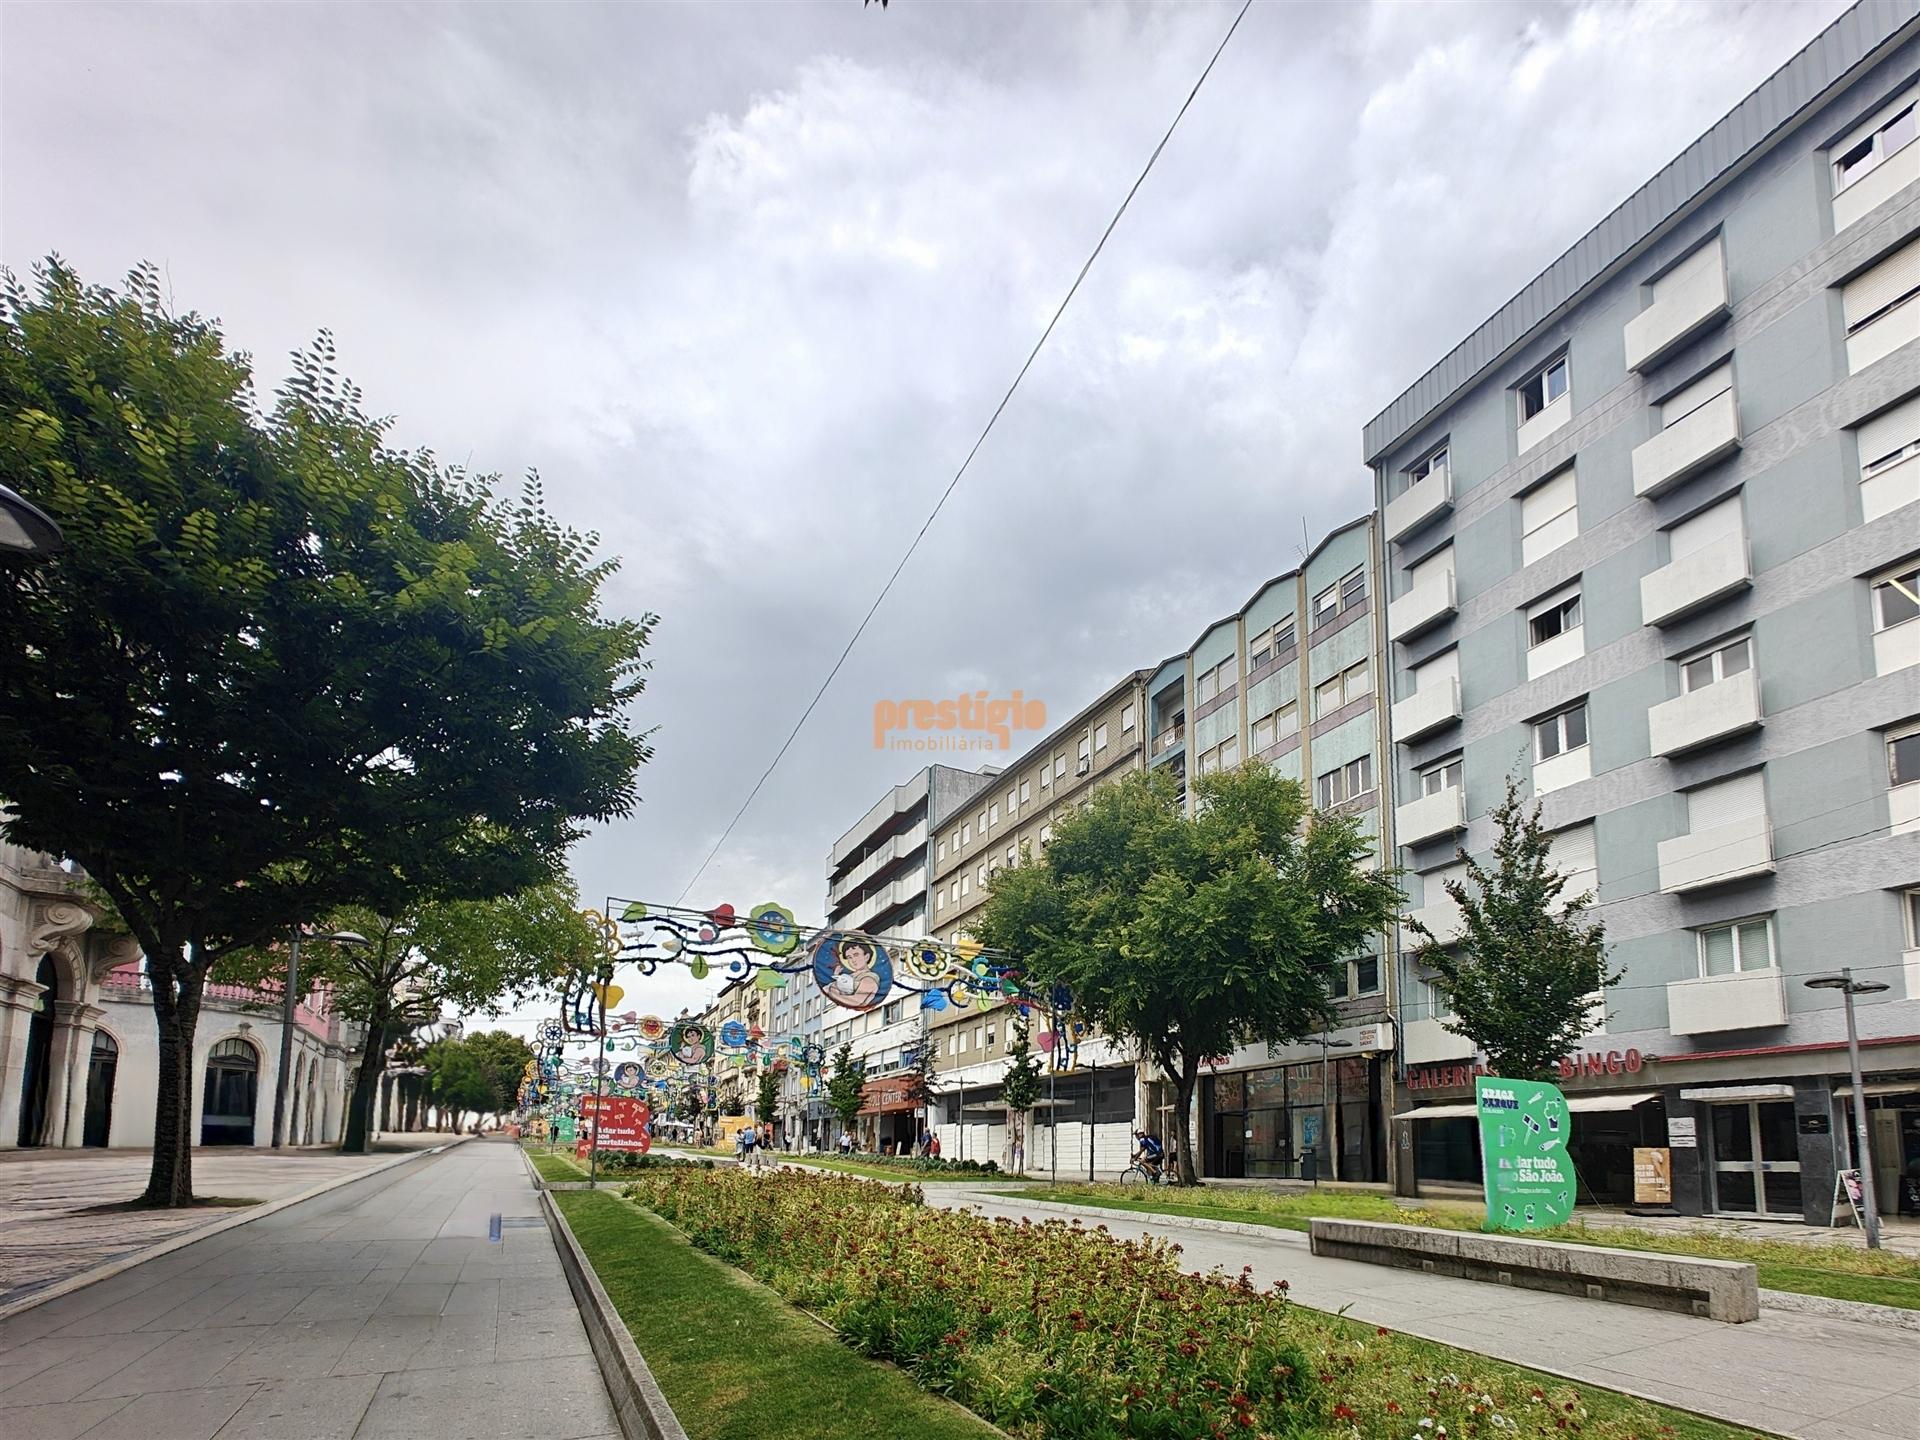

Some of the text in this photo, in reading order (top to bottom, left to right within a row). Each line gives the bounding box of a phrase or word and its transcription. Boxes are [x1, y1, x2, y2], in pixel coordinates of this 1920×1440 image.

[1560, 1048, 1642, 1078] BINGO
[881, 1091, 902, 1105] CENTER
[1482, 1098, 1519, 1109] PARQUE
[1532, 1156, 1557, 1170] tudo
[1519, 1168, 1539, 1182] São
[1539, 1169, 1564, 1183] João.
